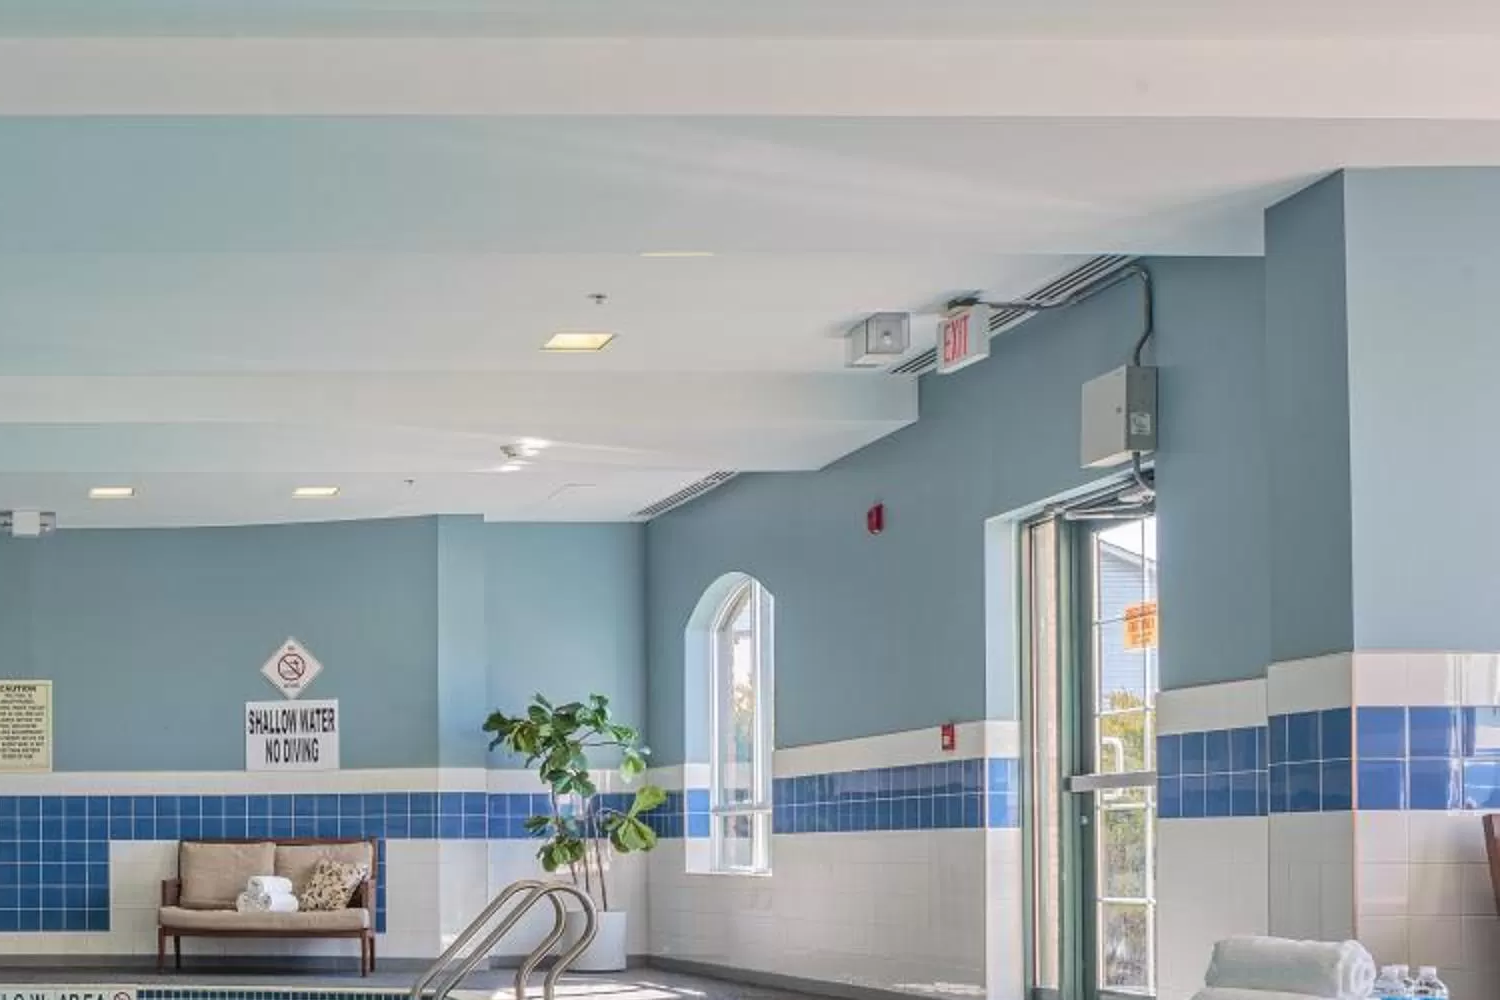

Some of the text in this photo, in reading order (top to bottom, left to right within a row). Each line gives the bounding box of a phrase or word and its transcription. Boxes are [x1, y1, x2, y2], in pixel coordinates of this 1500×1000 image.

[943, 315, 969, 362] EXIT
[248, 707, 335, 735] SHALLOW WATER
[265, 738, 319, 763] NO DIVING
